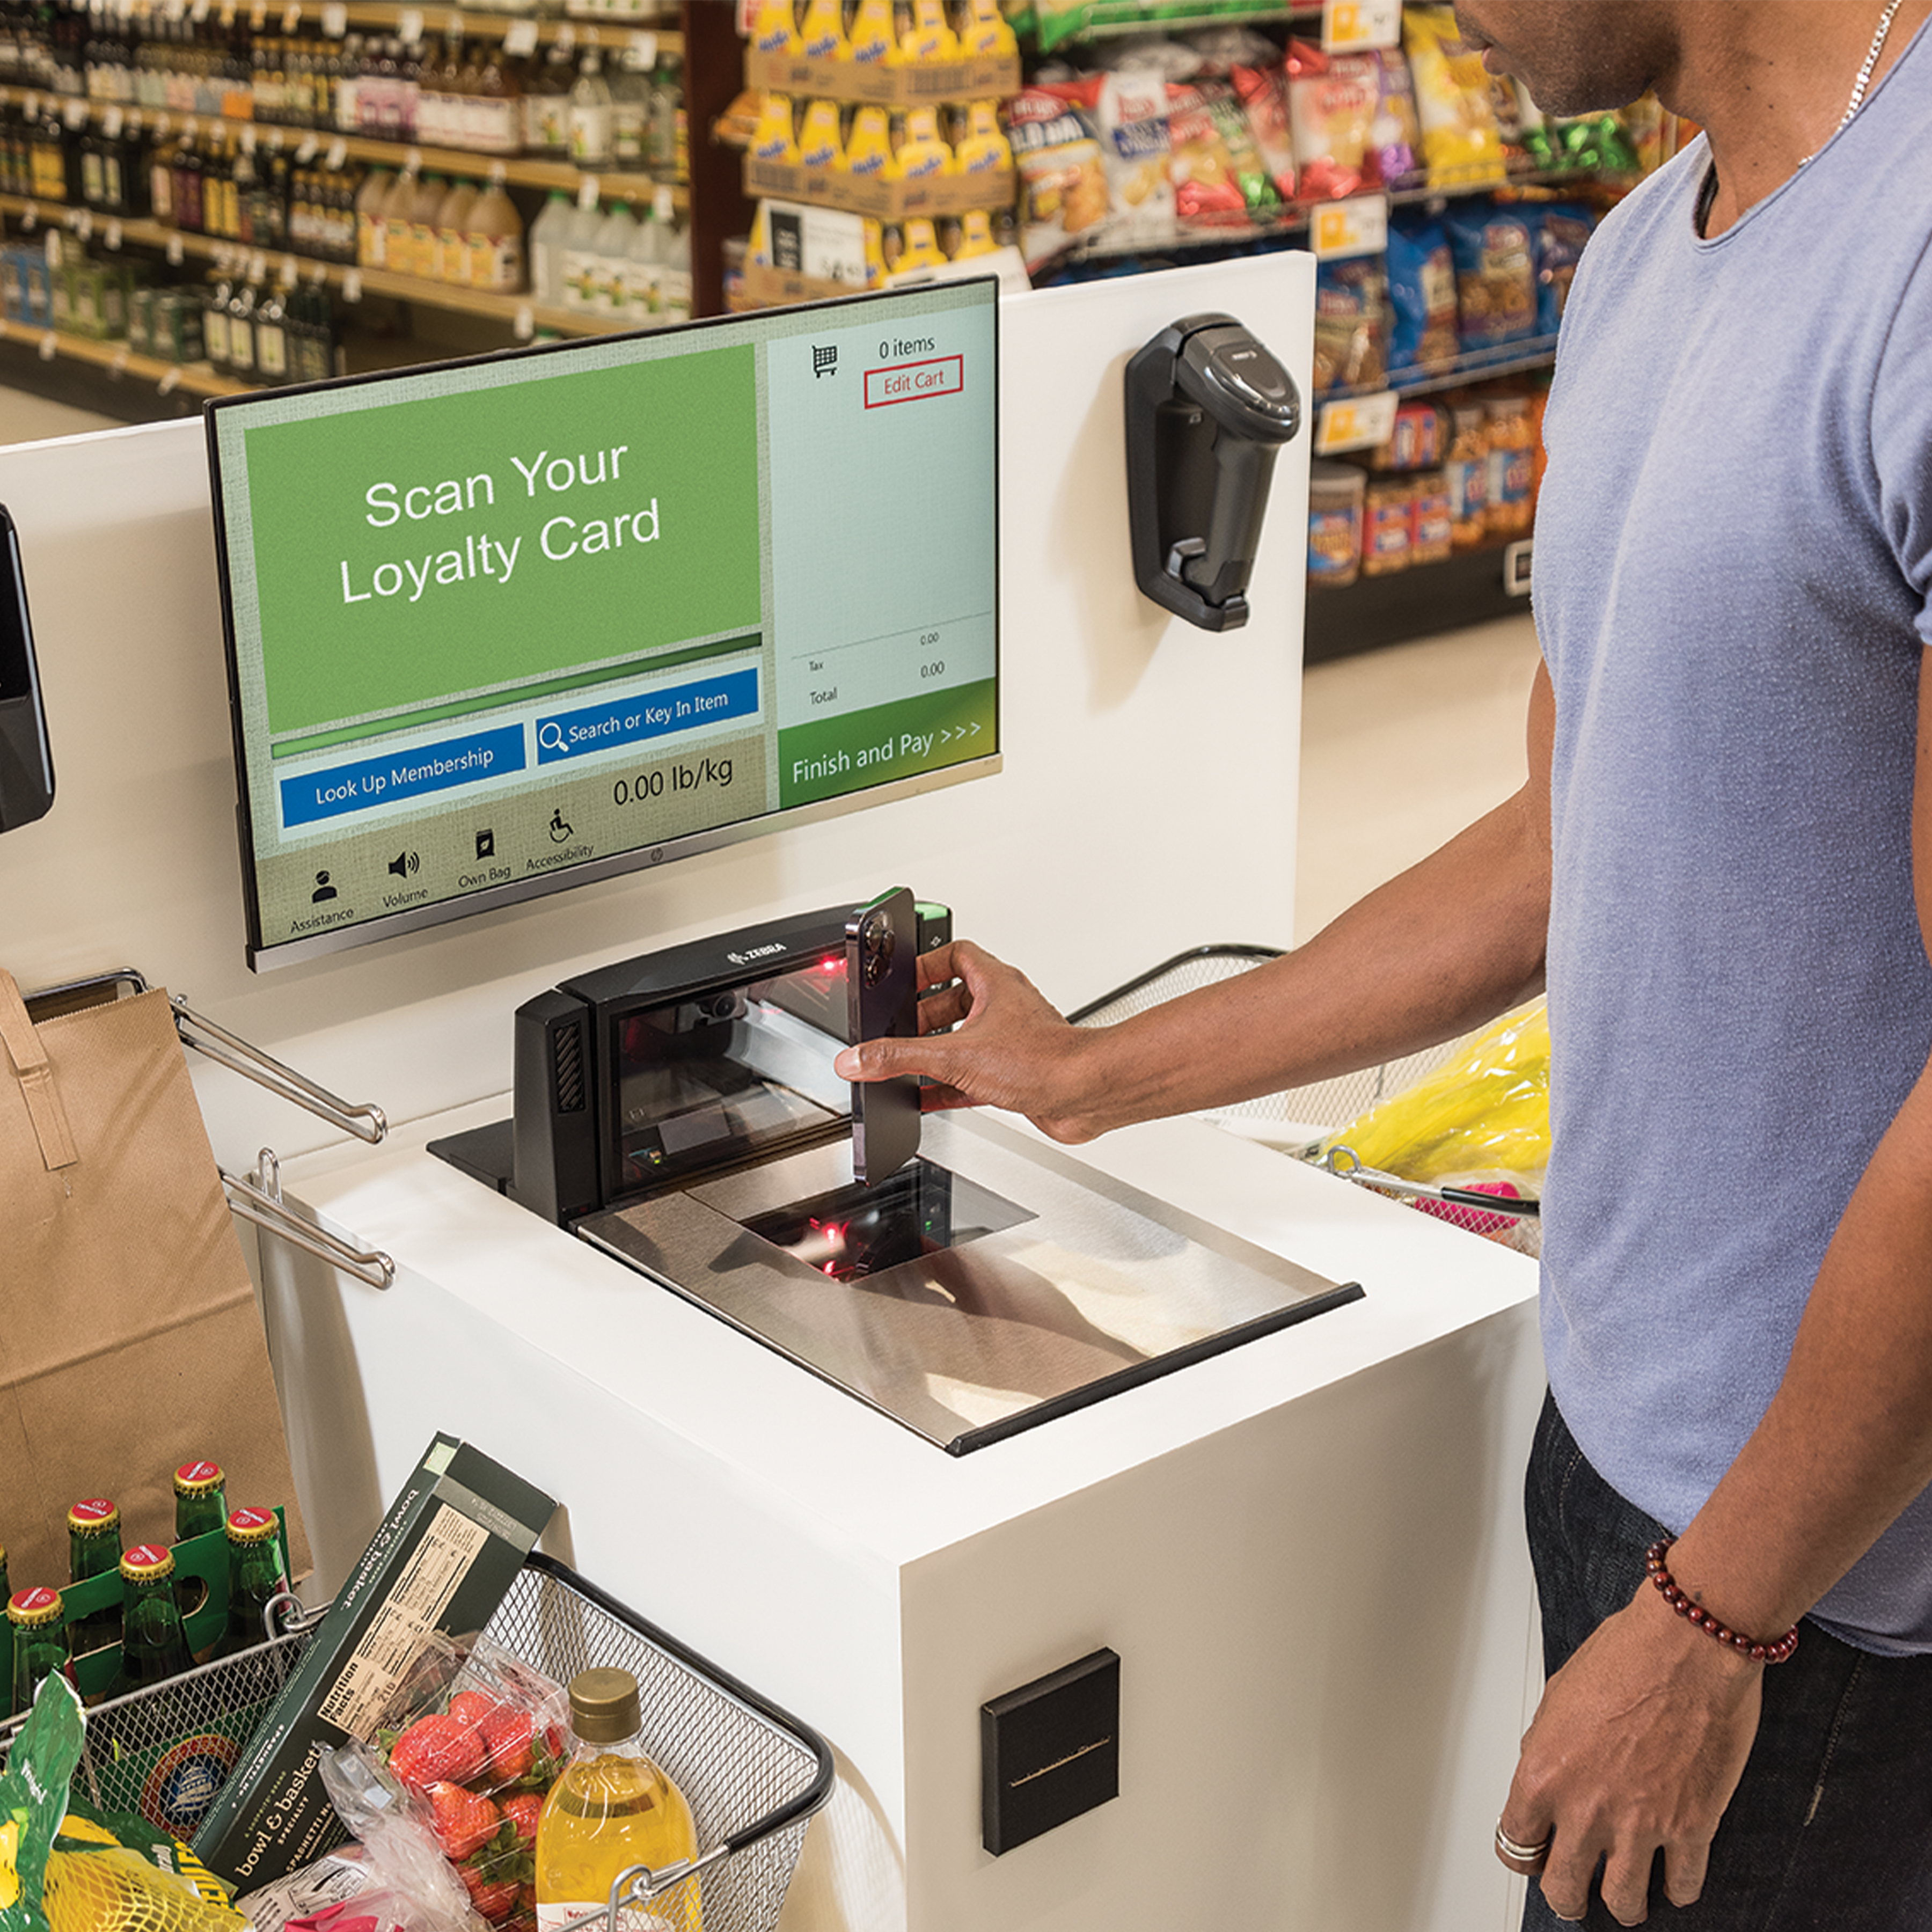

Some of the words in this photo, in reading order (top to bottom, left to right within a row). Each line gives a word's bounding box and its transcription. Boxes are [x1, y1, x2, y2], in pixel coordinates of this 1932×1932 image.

[879, 341, 889, 359] 0
[894, 337, 935, 356] items
[884, 376, 911, 394] Edit
[914, 370, 945, 389] Cart
[365, 473, 494, 528] Scan
[510, 445, 628, 497] Your
[341, 534, 522, 604] Loyalty
[540, 497, 660, 561] Card
[809, 661, 824, 672] Tax
[920, 632, 940, 646] 0.00
[809, 687, 838, 705] Total
[920, 661, 946, 678] 0.00
[568, 716, 621, 744] Search
[624, 714, 642, 729] or
[645, 707, 672, 724] Key
[676, 701, 691, 718] In
[694, 693, 729, 713] Item
[316, 780, 358, 805] Look
[362, 775, 386, 795] Up
[391, 747, 494, 786] Membership
[793, 750, 850, 784] Finish
[857, 738, 894, 767] and
[901, 733, 934, 758] Pay
[613, 771, 664, 806] 0.00
[672, 758, 733, 792] lb/kg
[457, 872, 487, 889] Own
[488, 866, 511, 880] Bag
[526, 845, 595, 871] Accessibility
[382, 889, 429, 908] Volume
[290, 908, 354, 934] Assistance
[745, 943, 787, 959] ZEBRA
[390, 1490, 419, 1529] bowl
[320, 1663, 357, 1717] Nutrition
[329, 1688, 355, 1722] Facts
[235, 1831, 272, 1876] bowl
[266, 1813, 282, 1829] &
[275, 1750, 324, 1810] basket
[278, 1797, 308, 1844] SPECIALTY
[287, 1818, 323, 1875] SPAGHETTI
